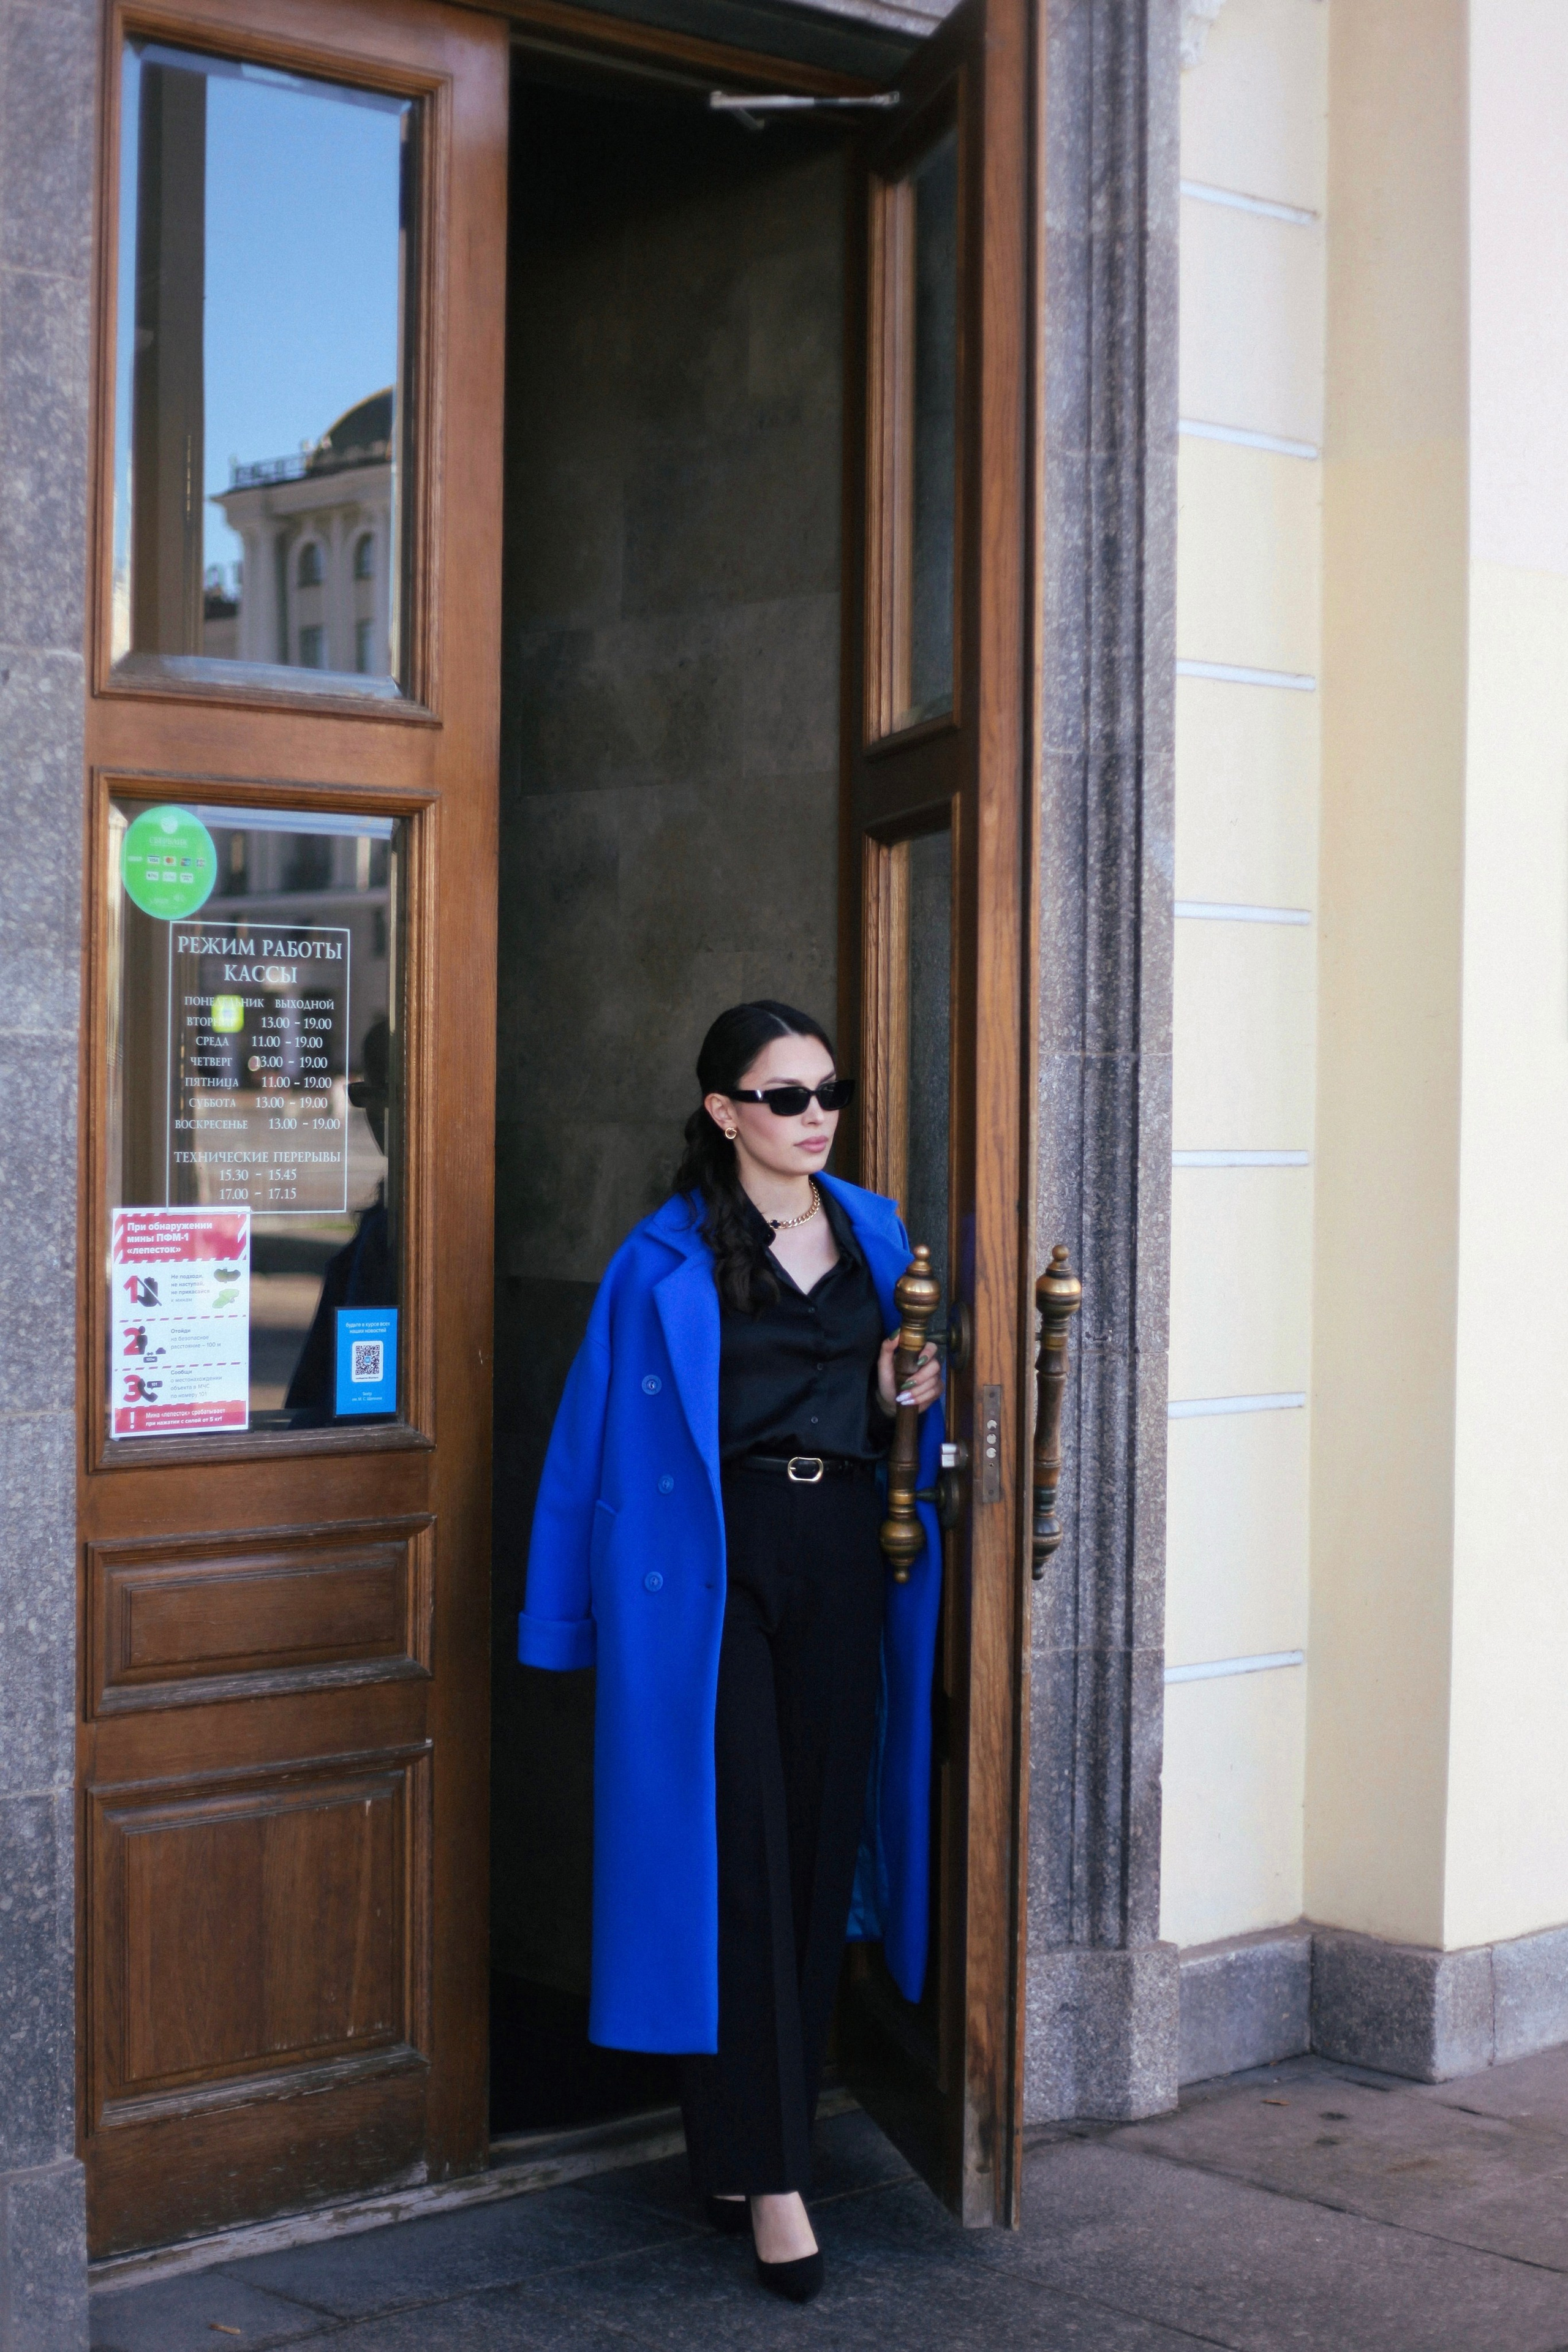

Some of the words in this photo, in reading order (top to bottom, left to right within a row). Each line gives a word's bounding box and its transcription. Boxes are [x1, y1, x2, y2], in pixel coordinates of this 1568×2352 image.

[177, 936, 255, 956] РЕЖИМ
[262, 940, 342, 960] РАБОТЫ
[224, 964, 298, 984] КАССЫ
[275, 999, 334, 1011] ВЫХОДНОЙ
[261, 1017, 290, 1029] 13.00
[303, 1017, 332, 1030] 19.00
[195, 1036, 229, 1048] СРЕДА
[252, 1036, 281, 1047] 11.00
[295, 1036, 323, 1048] 19.00
[190, 1057, 233, 1067] ЧЕТВЕРГ
[254, 1056, 283, 1068] 13.00
[300, 1057, 328, 1069] 19.00
[185, 1077, 239, 1090] ПЯТНИЦА
[262, 1076, 290, 1088] 11.00
[304, 1077, 332, 1088] 19.00
[189, 1098, 236, 1109] СУББОТА
[255, 1097, 284, 1109] 13.00
[300, 1097, 328, 1109] 19.00
[175, 1120, 248, 1129] ВОСКРЕСЕНЬЕ
[268, 1118, 297, 1129] 13.00
[312, 1118, 341, 1129] 19.00
[174, 1152, 269, 1163] ТЕХНИЧЕСКИЕ
[274, 1152, 341, 1163] ПЕРЕРЫВЫ
[219, 1169, 249, 1181] 15.30
[268, 1169, 297, 1180] 15.45
[219, 1188, 249, 1200] 17.00
[268, 1188, 296, 1199] 17.15
[127, 1223, 146, 1233] При
[148, 1221, 213, 1232] обнаружении
[156, 1233, 189, 1242] ПФМ-1
[123, 1275, 138, 1303] 1
